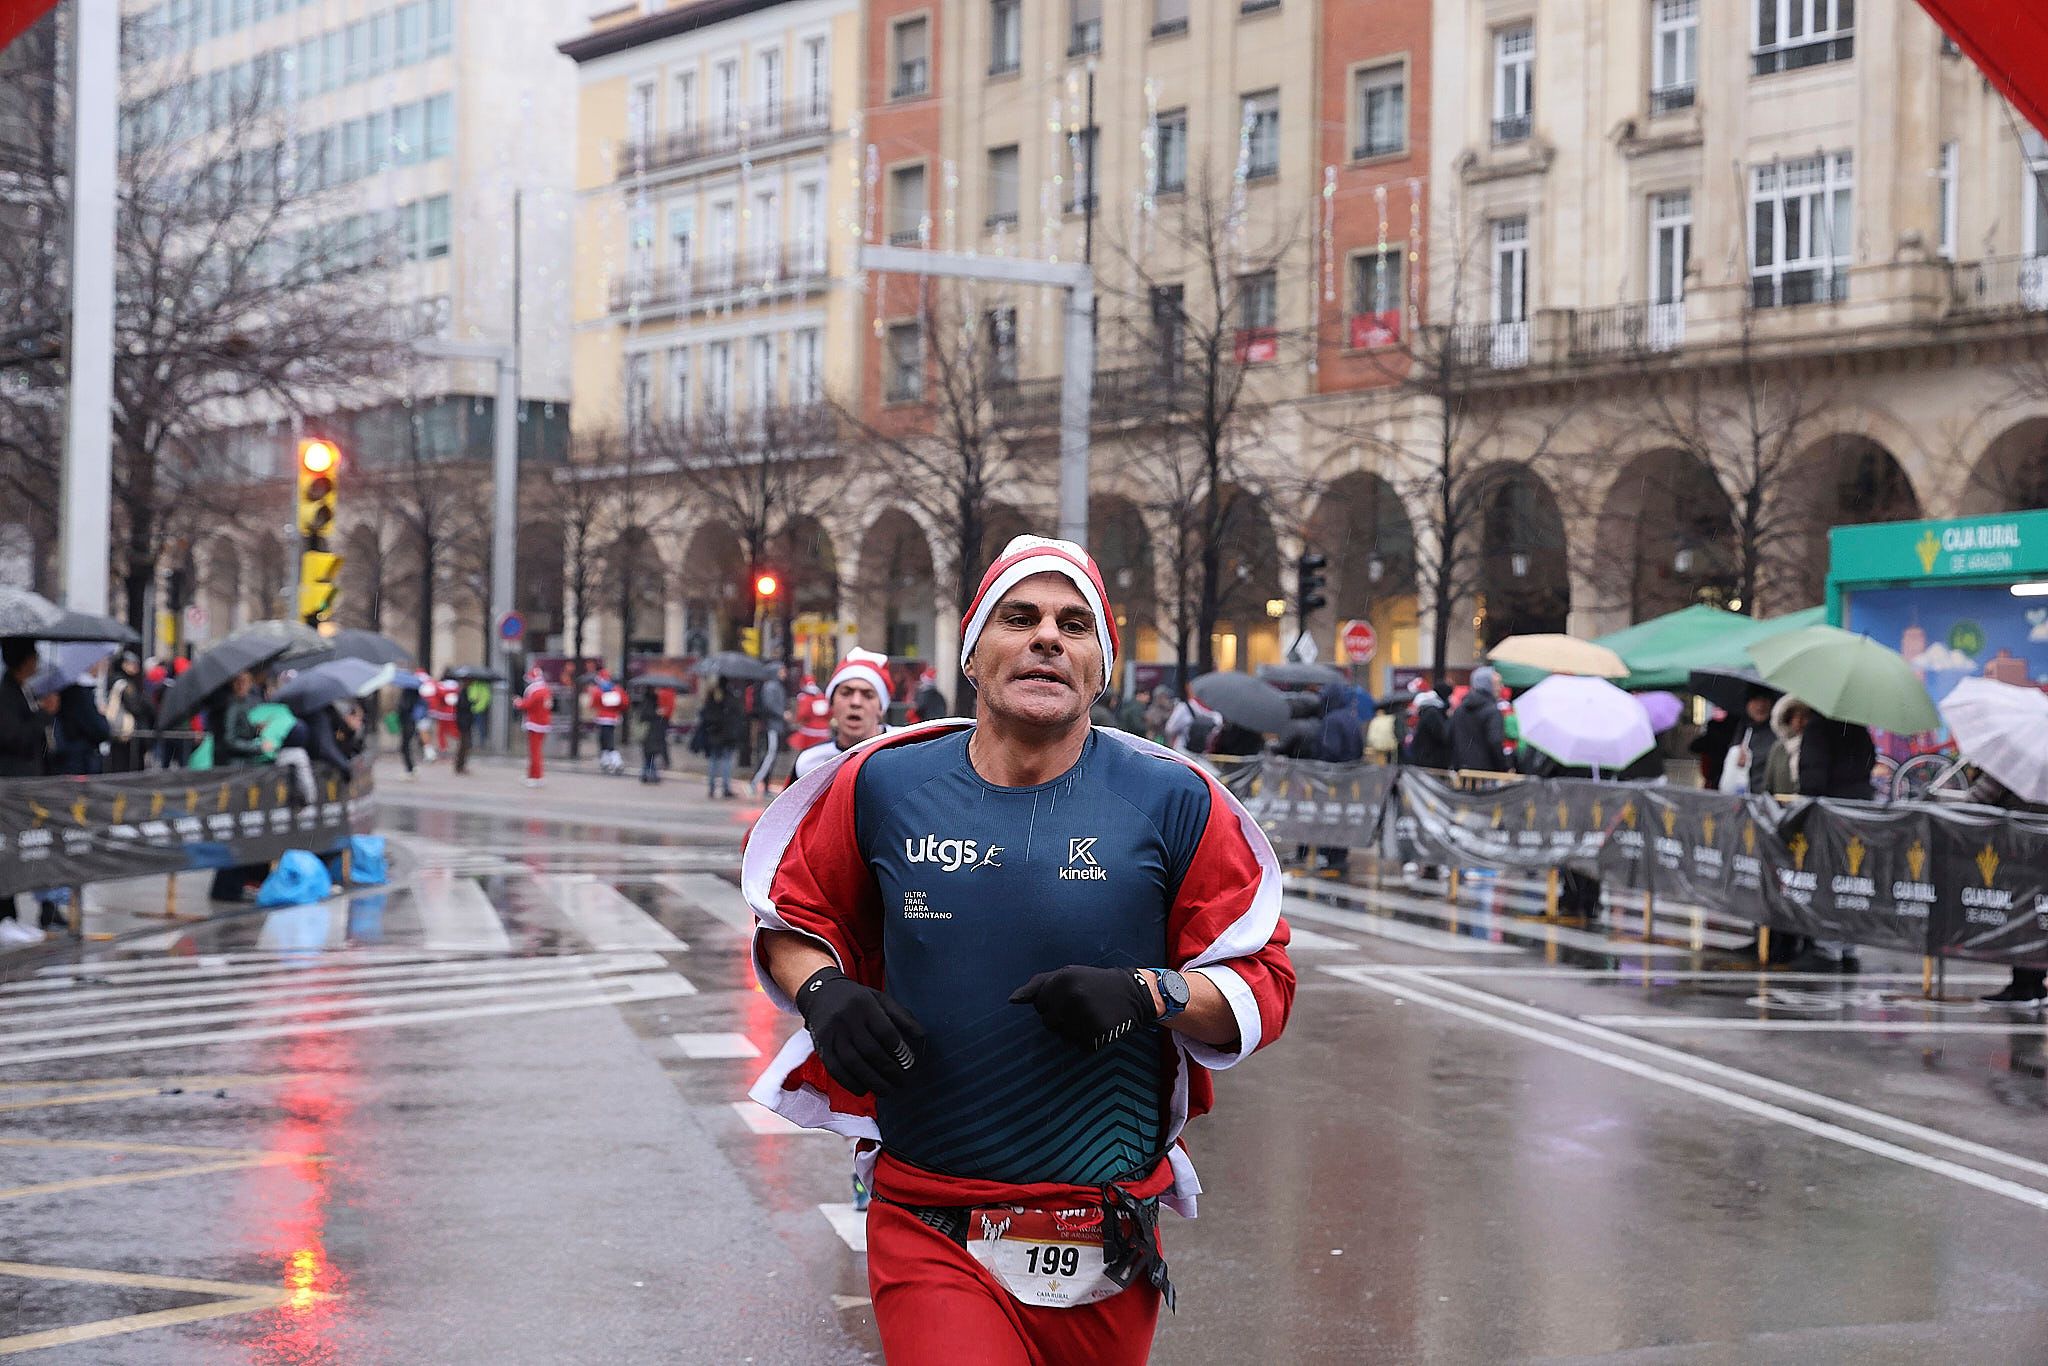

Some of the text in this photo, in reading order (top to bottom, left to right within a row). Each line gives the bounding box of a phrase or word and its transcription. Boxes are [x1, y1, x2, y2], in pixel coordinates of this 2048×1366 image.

[905, 833, 978, 872] utgs
[1059, 866, 1107, 881] kinetik
[904, 891, 927, 899] ULTRA
[1026, 1246, 1080, 1277] 199
